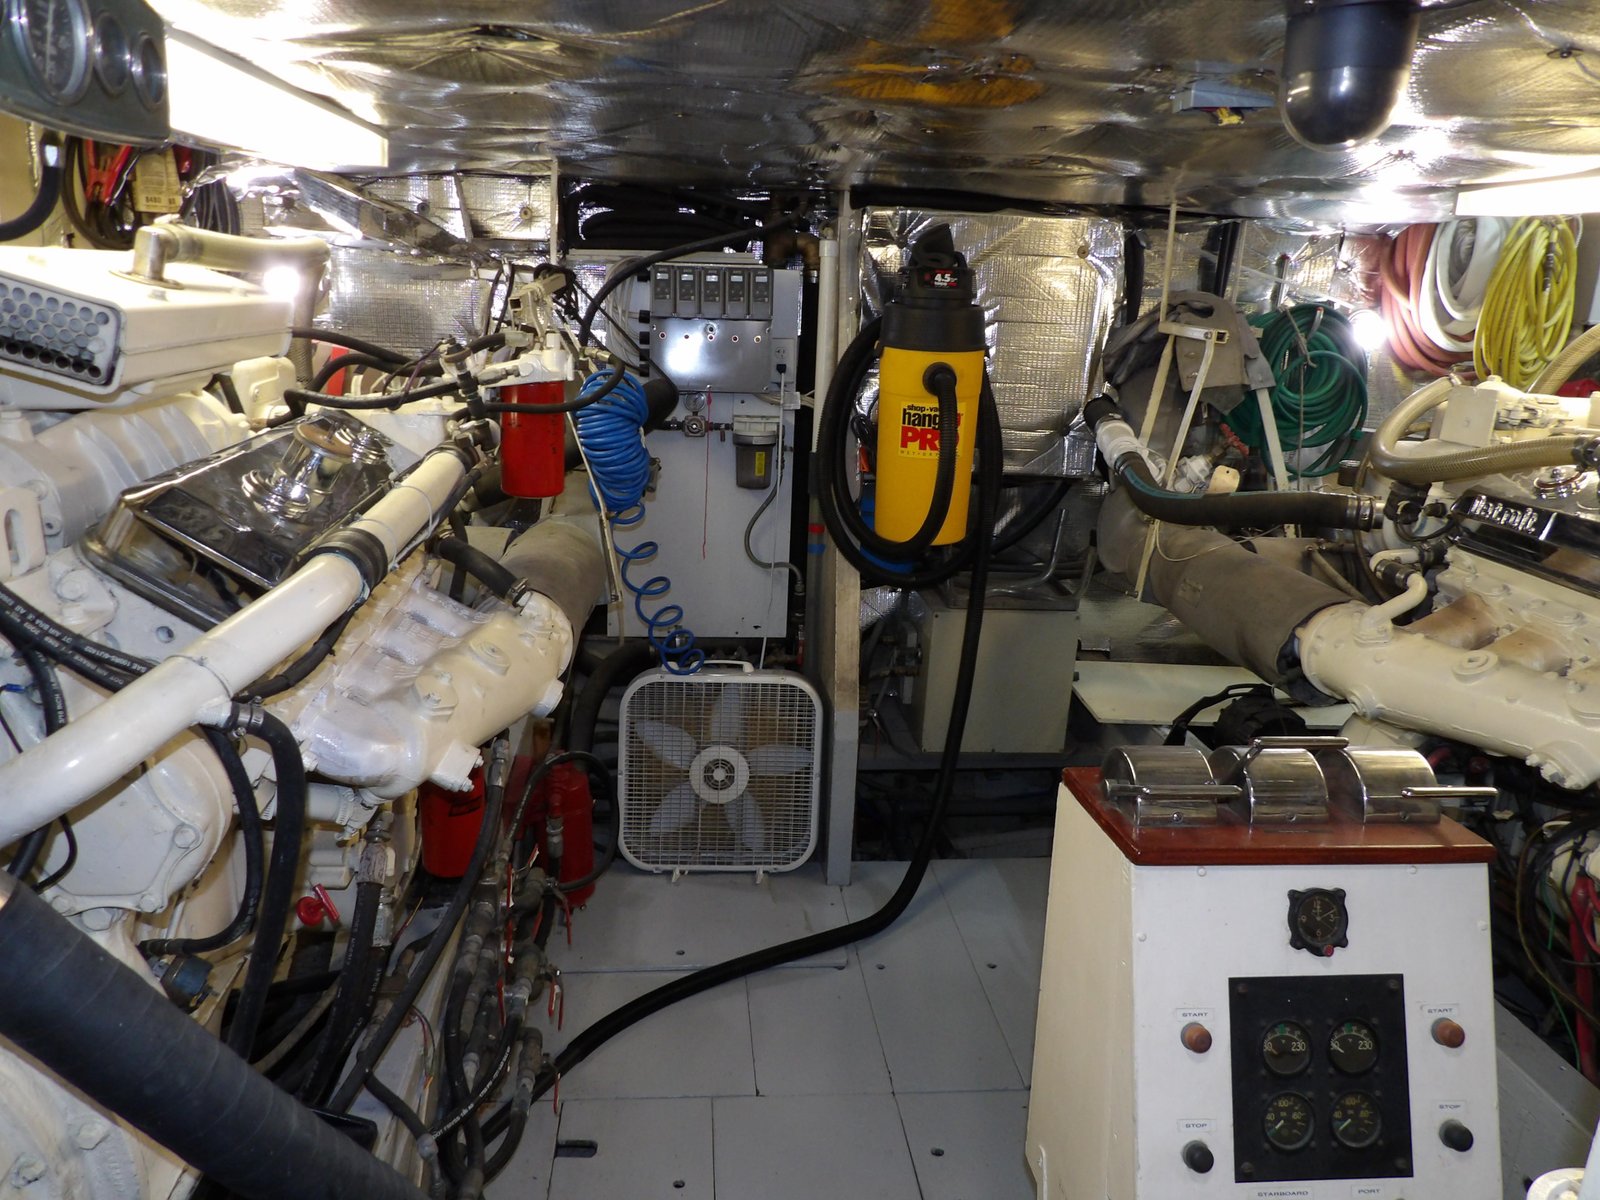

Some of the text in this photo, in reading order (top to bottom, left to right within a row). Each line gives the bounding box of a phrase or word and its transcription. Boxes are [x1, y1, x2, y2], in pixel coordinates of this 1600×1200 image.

[934, 273, 951, 283] 4.5
[1291, 1041, 1306, 1051] 230
[1358, 1040, 1373, 1050] 230
